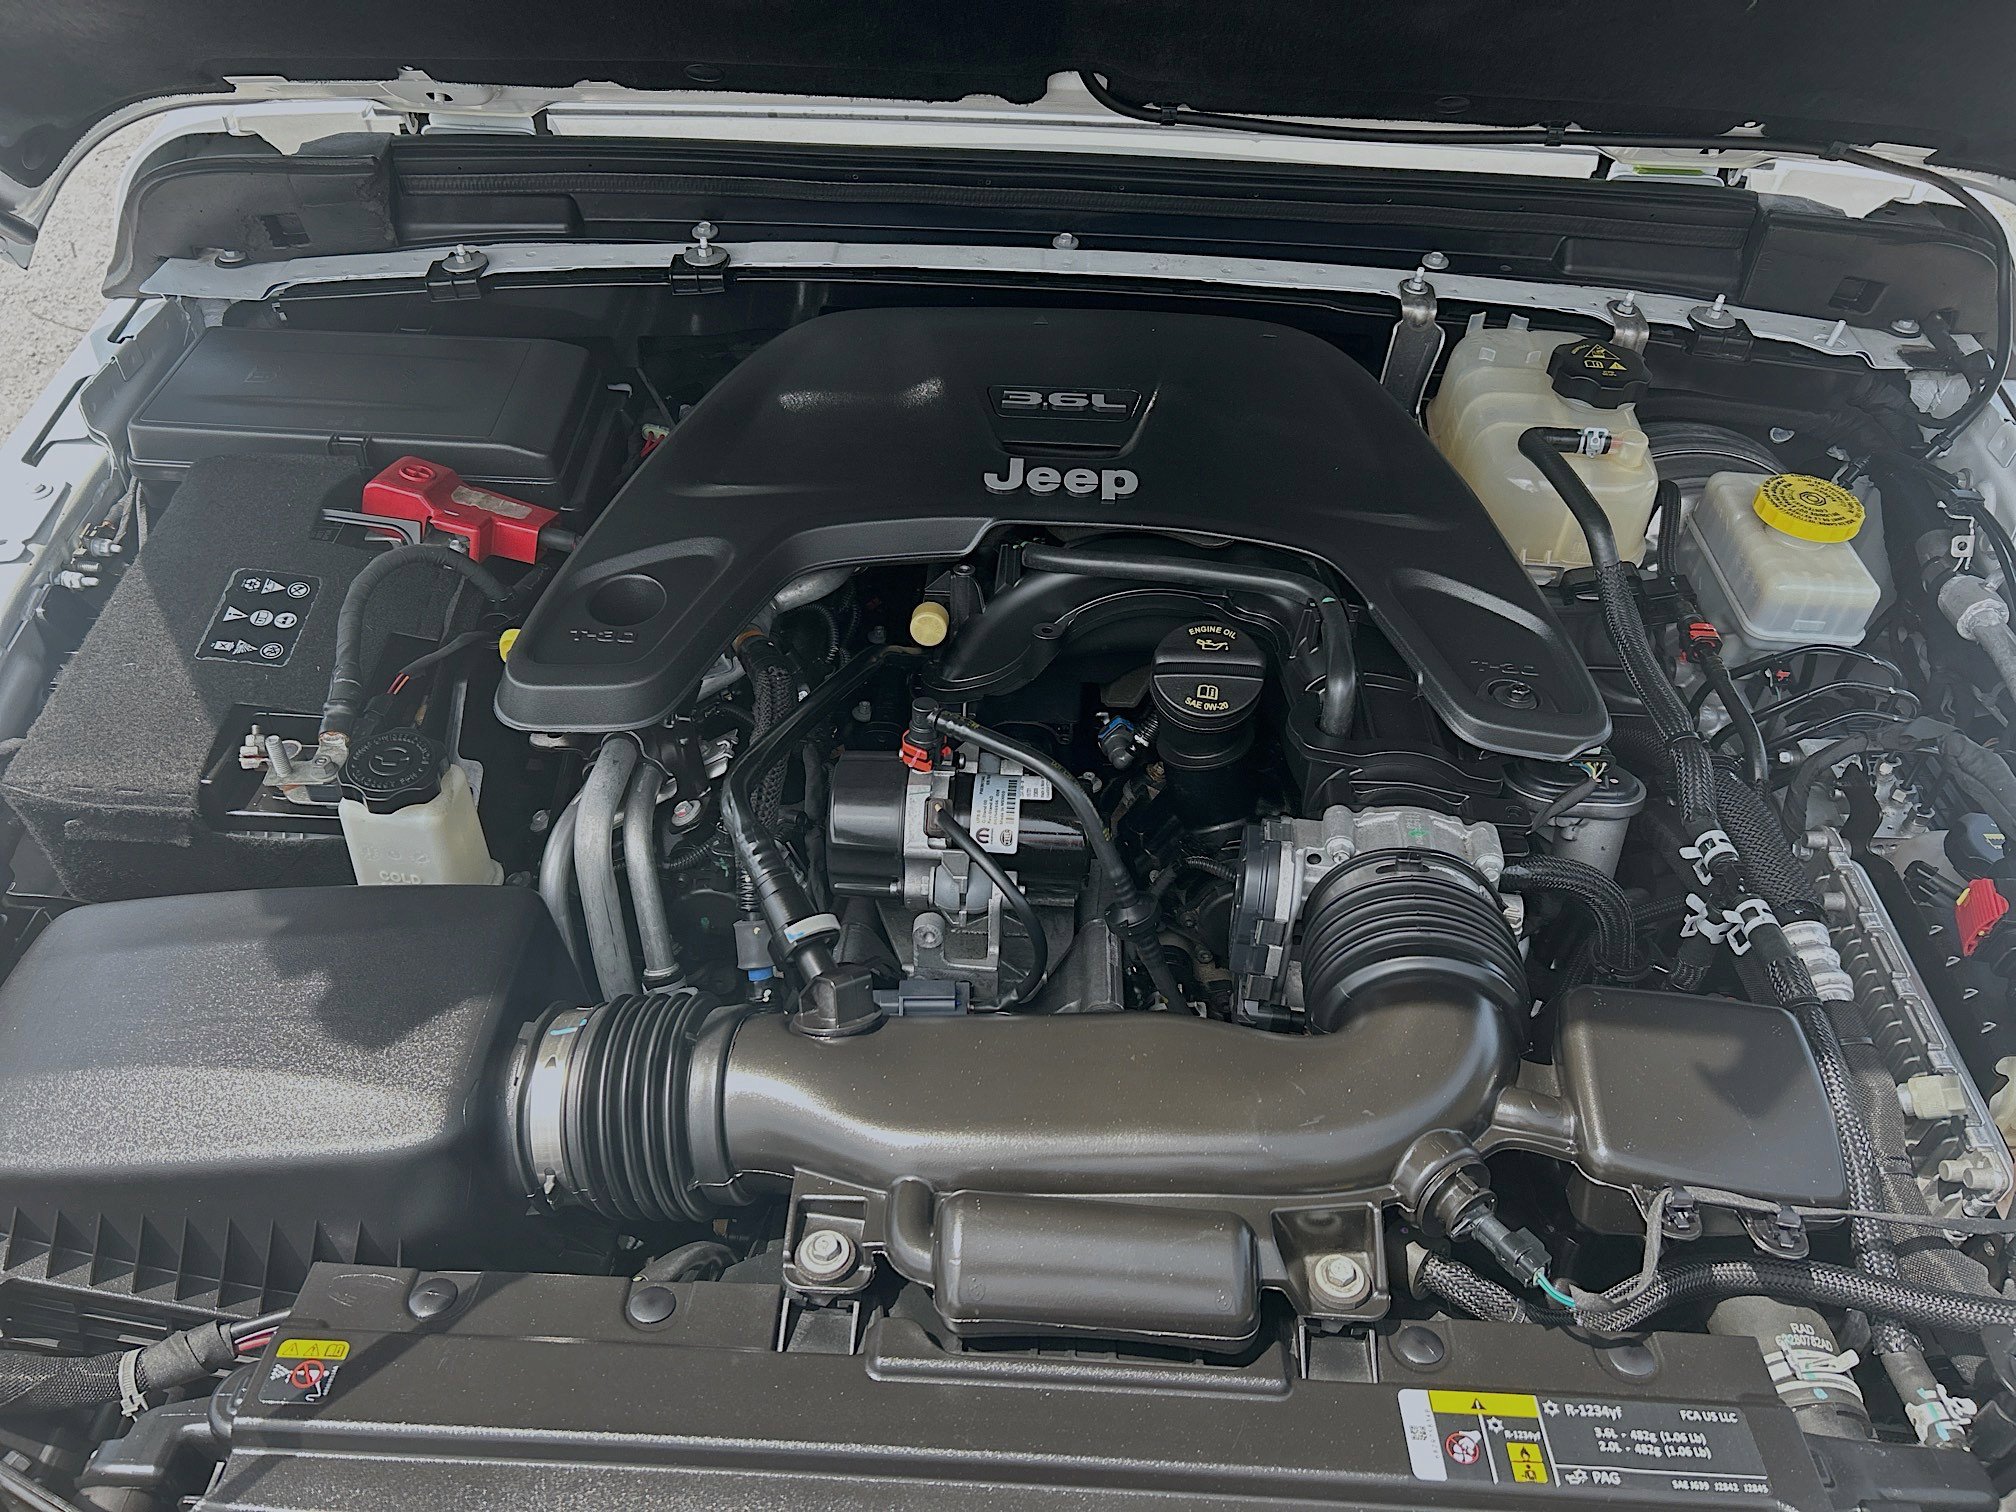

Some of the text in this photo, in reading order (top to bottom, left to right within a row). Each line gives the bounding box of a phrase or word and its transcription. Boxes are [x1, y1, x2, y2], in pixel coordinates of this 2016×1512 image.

[1001, 390, 1127, 413] 3.6L
[983, 457, 1139, 504] Jeep
[1188, 625, 1237, 640] ENGINE OIL
[1184, 696, 1230, 711] SAE 0W-20
[379, 870, 422, 885] COLD
[1790, 1322, 1815, 1336] RAD
[1564, 1403, 1622, 1421] R-1234yf
[1680, 1409, 1738, 1423] FCA US LLC
[1594, 1426, 1618, 1439] 3.6L
[1598, 1440, 1622, 1453] 2.0L
[1592, 1470, 1621, 1485] PAG
